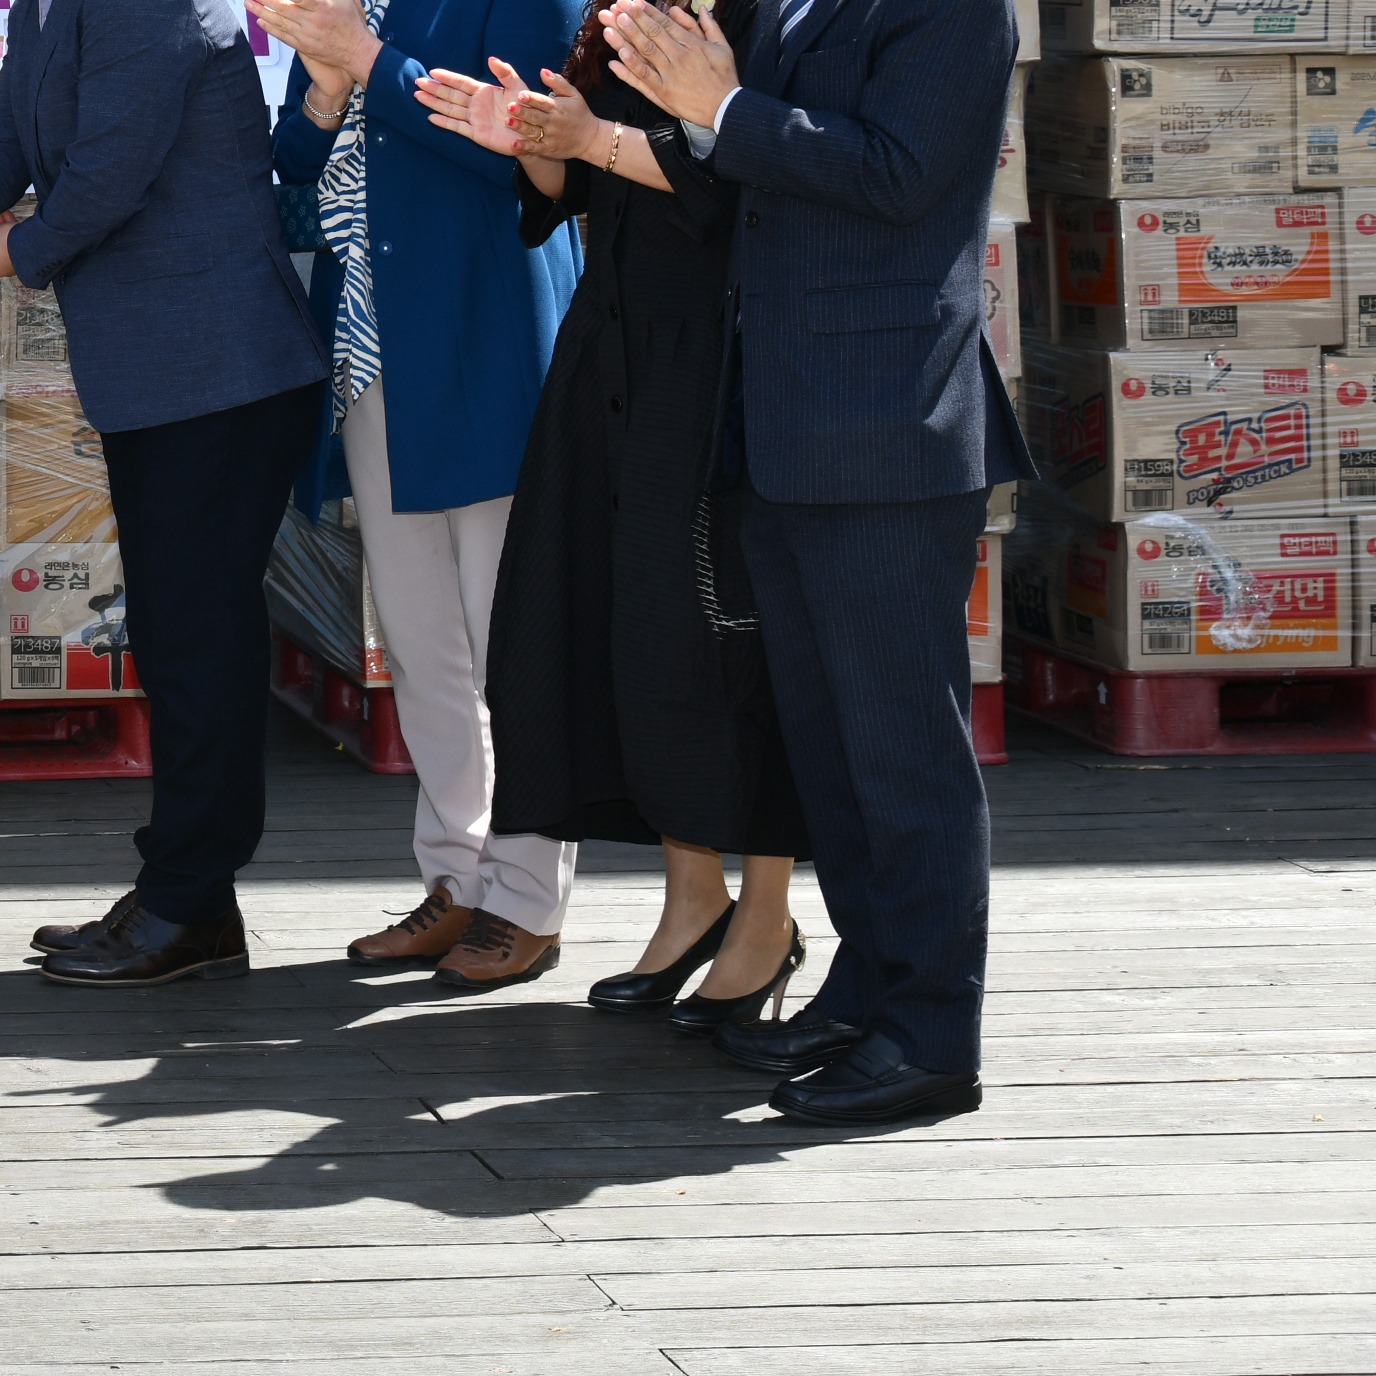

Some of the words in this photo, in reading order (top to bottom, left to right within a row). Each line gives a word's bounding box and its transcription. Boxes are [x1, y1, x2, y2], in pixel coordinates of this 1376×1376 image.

[1160, 102, 1205, 118] bibigo
[1160, 120, 1212, 135] 비비고
[1279, 208, 1322, 225] 멀티팩
[1162, 218, 1201, 235] 농심
[1206, 245, 1299, 272] 安城湯麵
[1191, 309, 1234, 322] 가3481
[1150, 379, 1192, 398] 농심
[1267, 374, 1292, 390] 84
[1293, 376, 1305, 392] g
[1182, 407, 1306, 475] 포스틱
[1126, 461, 1173, 474] 나1598
[1187, 474, 1247, 505] POTO
[1247, 462, 1291, 487] STICK
[1283, 535, 1334, 555] 멀티팩
[44, 562, 70, 571] 라면은
[71, 562, 90, 571] 농심
[43, 572, 90, 591] 농심
[1260, 577, 1326, 612] 건면
[13, 639, 60, 653] 가3487
